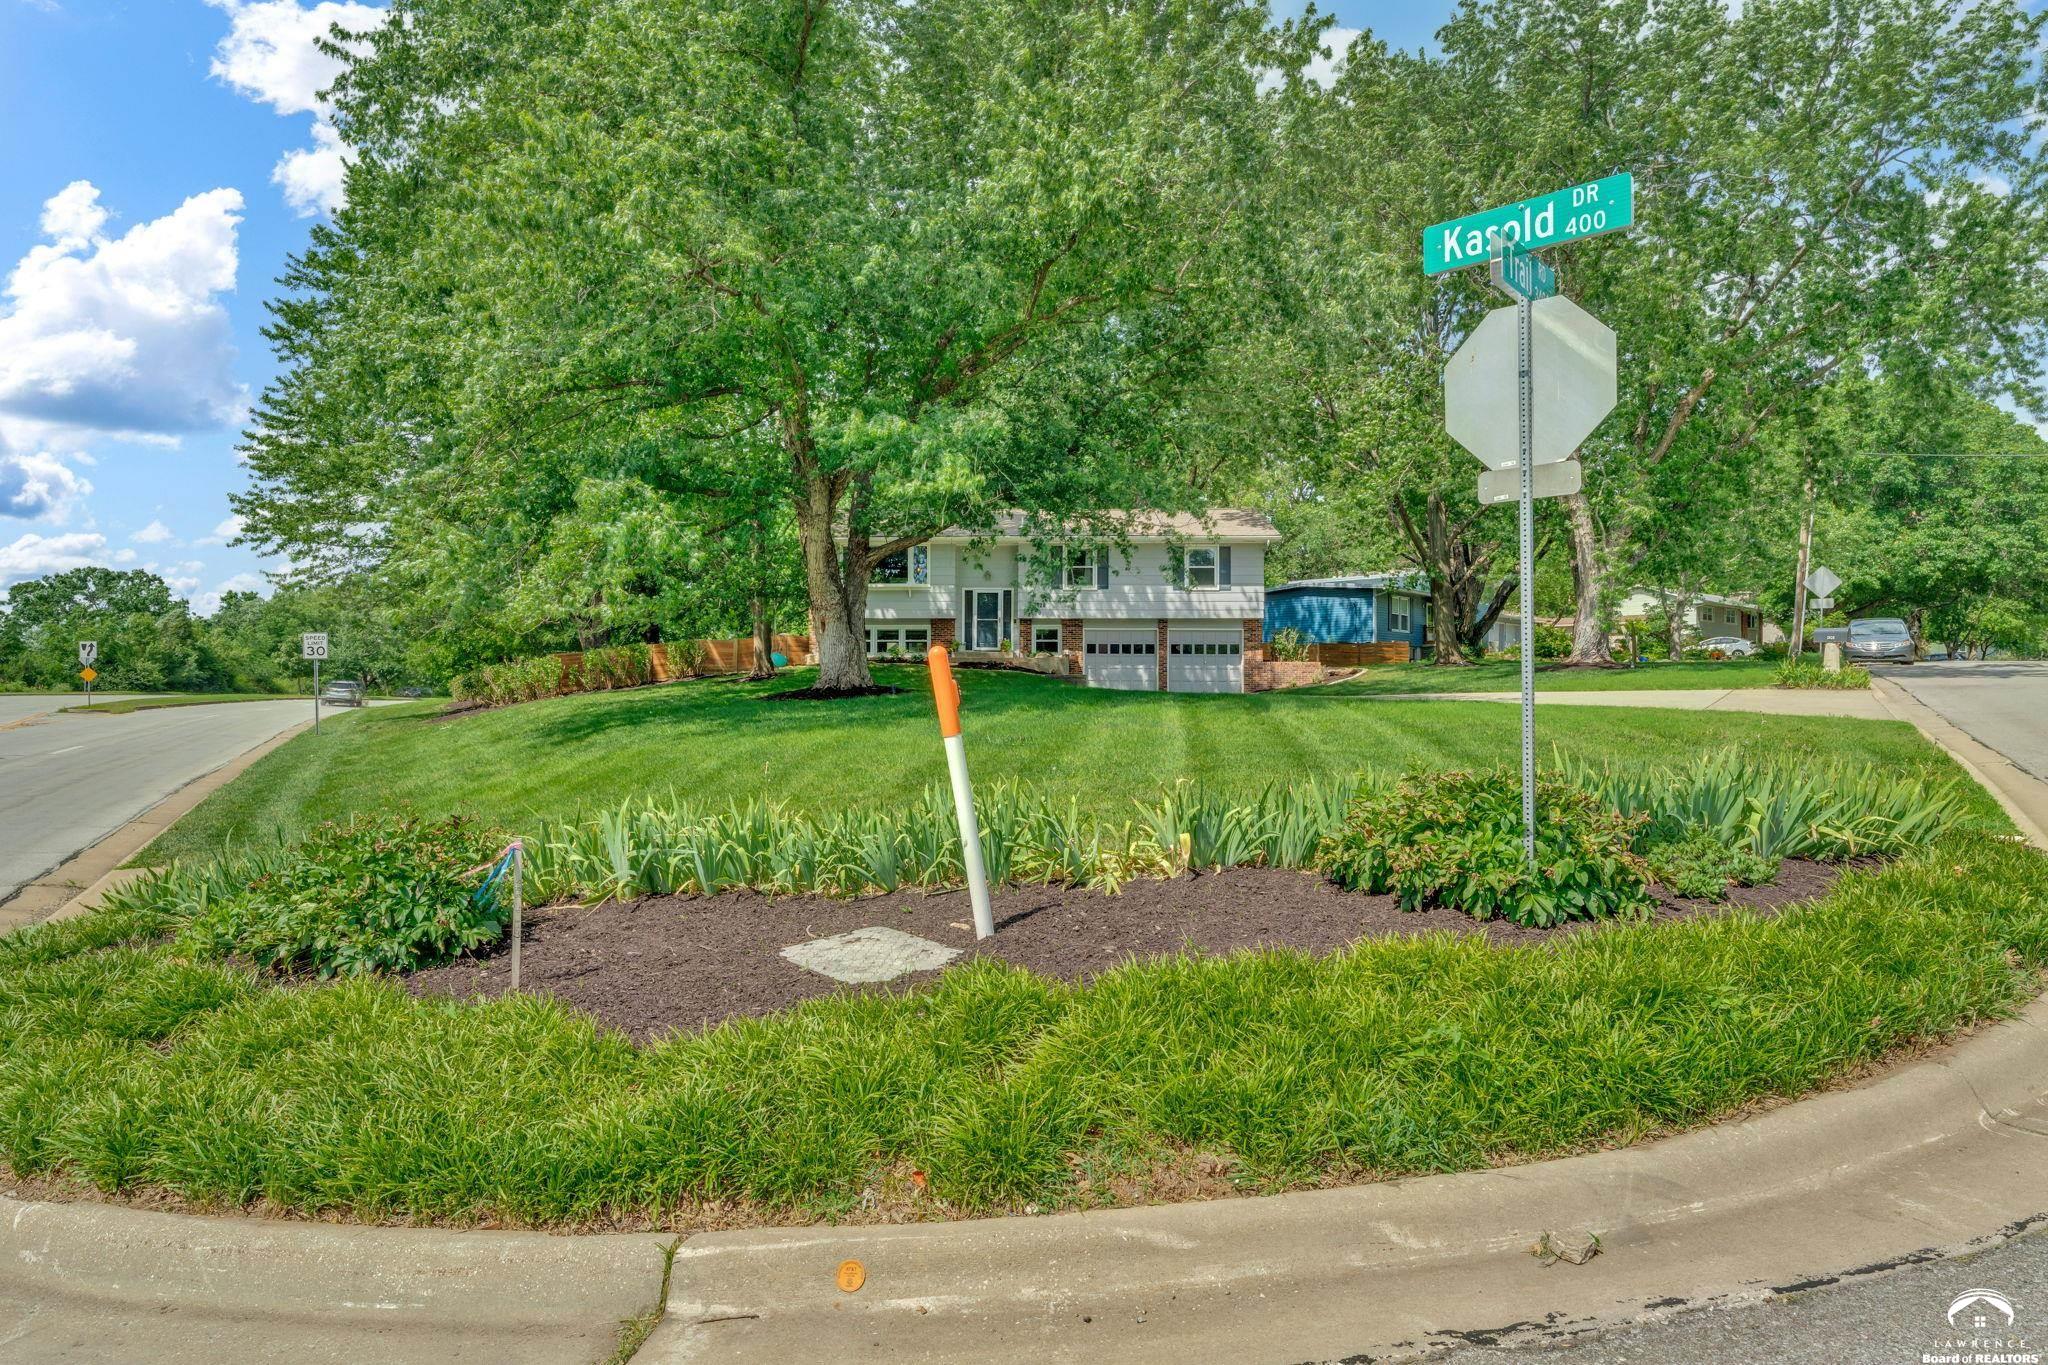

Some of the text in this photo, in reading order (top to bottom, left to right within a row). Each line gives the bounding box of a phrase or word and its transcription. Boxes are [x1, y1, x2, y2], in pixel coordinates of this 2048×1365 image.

[1443, 184, 1599, 262] Kasold DR
[1565, 210, 1606, 236] 400
[1506, 242, 1533, 297] Trail
[306, 646, 326, 656] 30
